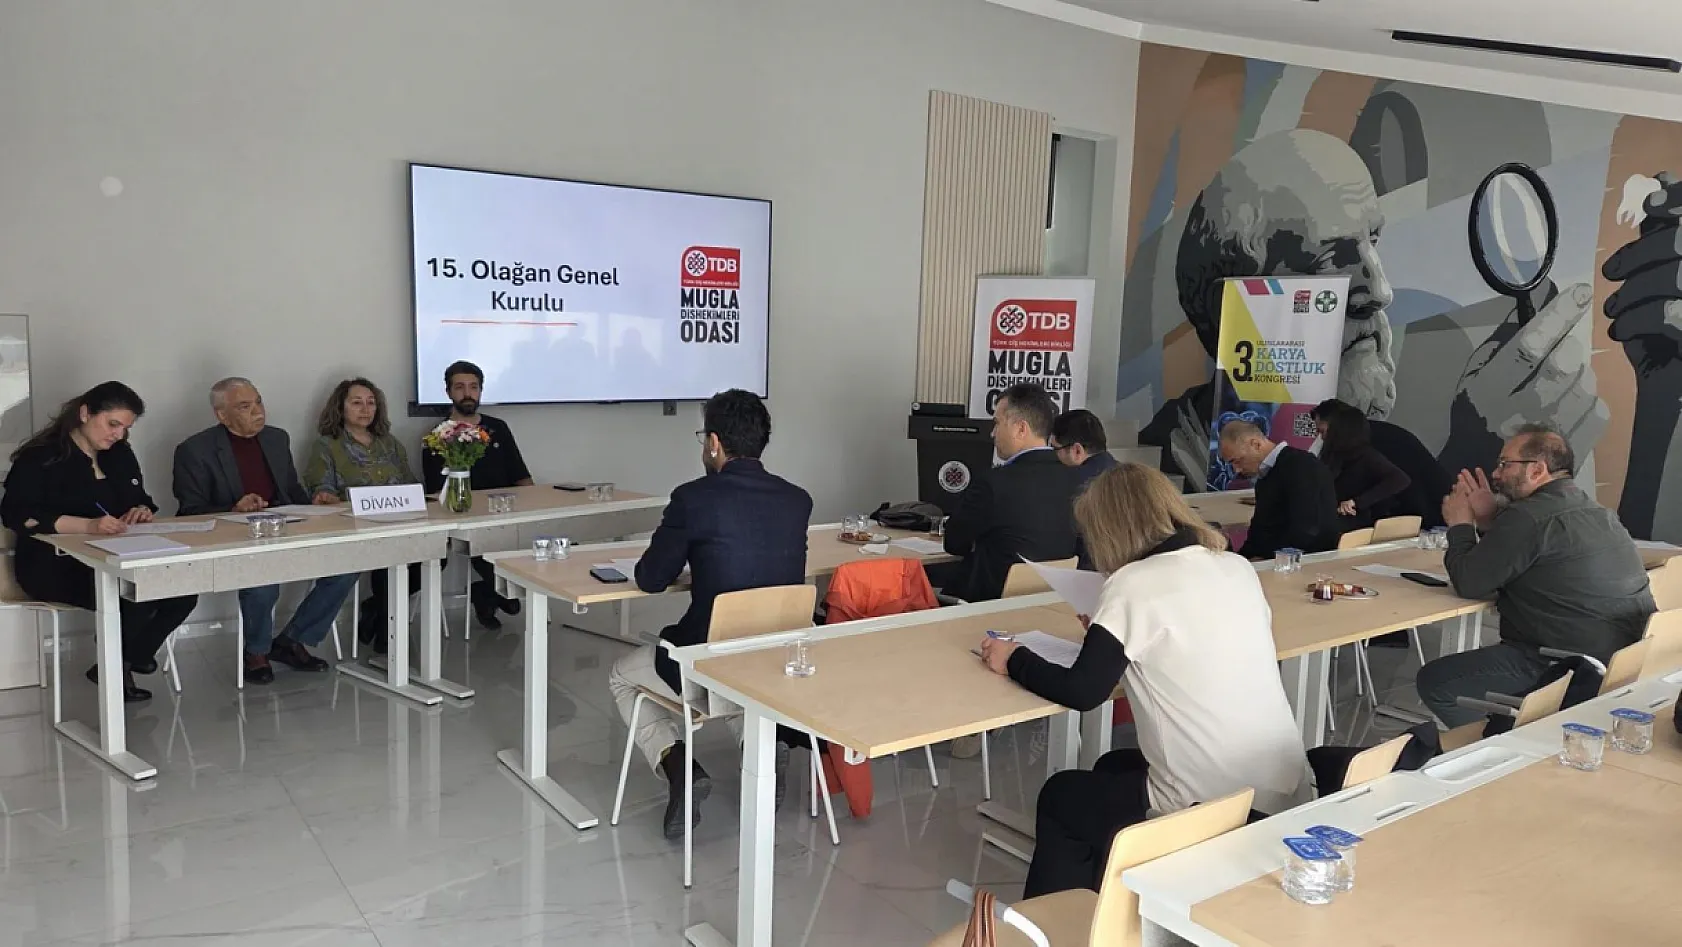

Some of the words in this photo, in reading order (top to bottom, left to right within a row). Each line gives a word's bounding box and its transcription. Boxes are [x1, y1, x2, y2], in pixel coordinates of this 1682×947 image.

[427, 257, 464, 279] 15.
[471, 259, 551, 286] Olağan
[557, 264, 620, 286] Genel
[708, 258, 737, 272] TDB
[492, 290, 564, 312] Kurulu
[1028, 312, 1071, 331] TDB
[681, 320, 740, 343] ODASI
[1233, 340, 1253, 382] 3.
[1256, 347, 1307, 360] KARYA
[1256, 361, 1326, 375] DOSTLUK
[361, 496, 404, 511] DİVAN
